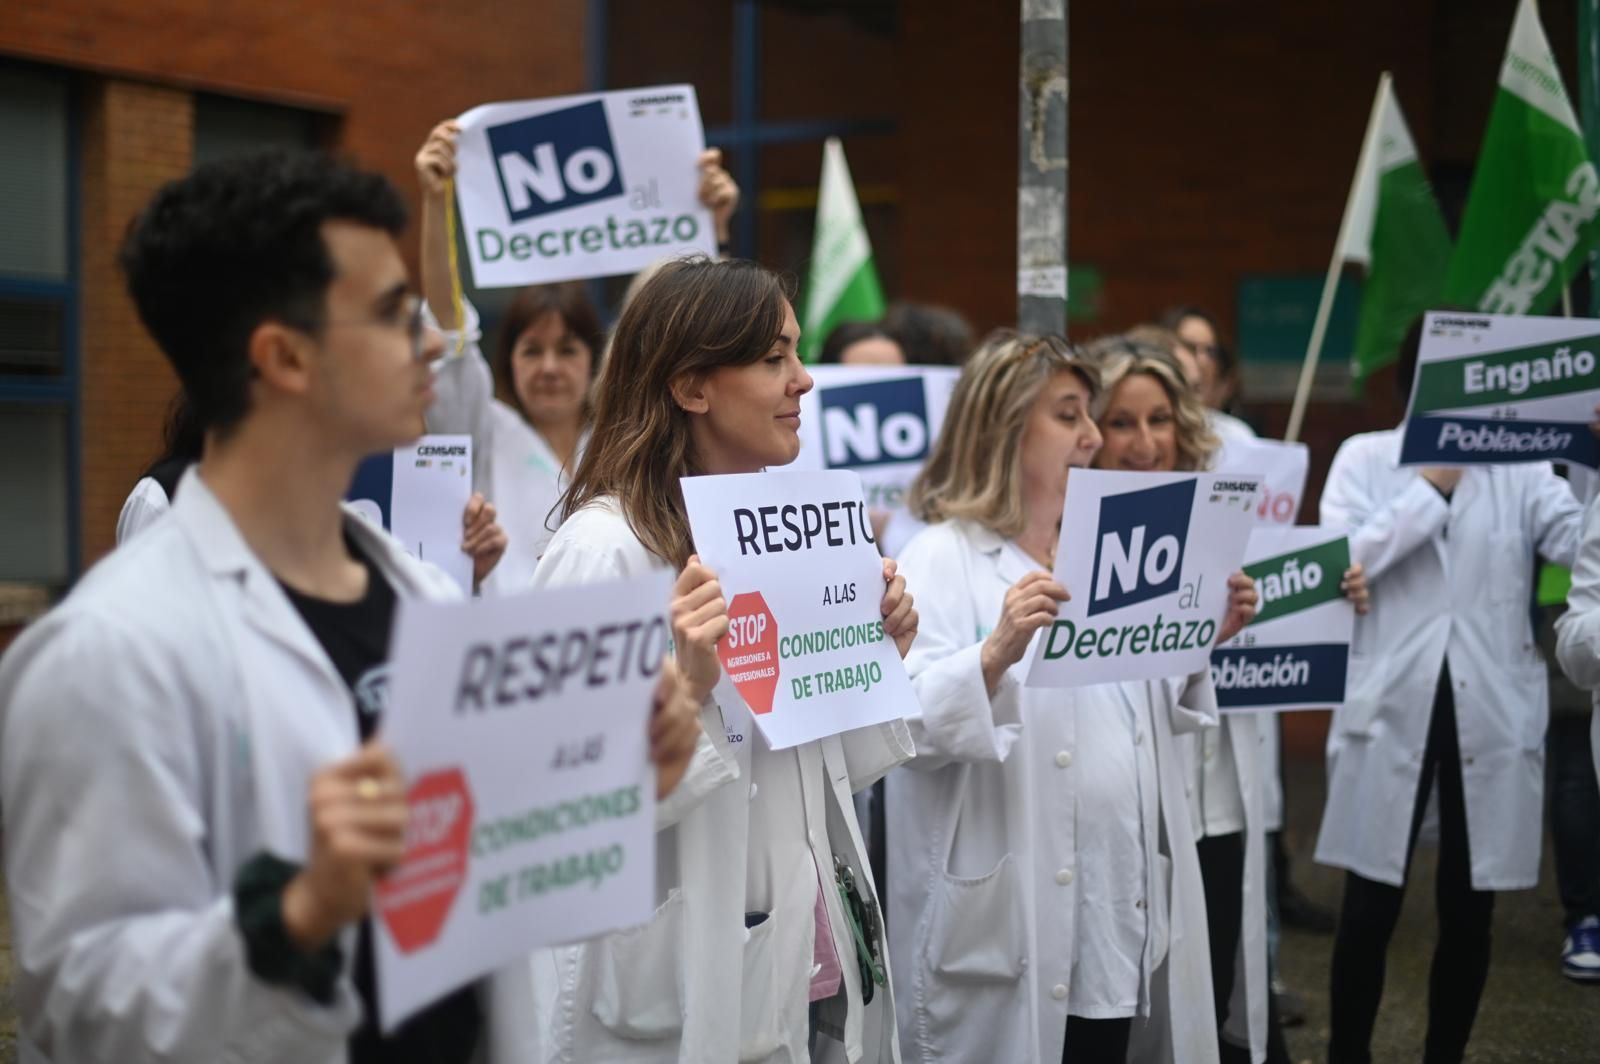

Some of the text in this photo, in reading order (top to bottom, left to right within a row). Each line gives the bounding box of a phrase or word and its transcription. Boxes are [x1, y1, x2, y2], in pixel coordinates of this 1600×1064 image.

[498, 142, 615, 213] No
[629, 178, 660, 209] al
[476, 214, 699, 263] Decretazo
[1463, 346, 1595, 394] Engaño
[824, 403, 926, 464] No
[1437, 421, 1572, 452] Población
[1095, 524, 1180, 601] No
[823, 582, 857, 606] A LAS
[1178, 573, 1203, 610] al
[727, 612, 767, 648] STOP
[779, 620, 884, 659] CONDICIONES
[1043, 613, 1216, 660] Decretazo
[456, 617, 666, 713] RESPETO
[727, 652, 766, 668] AGRESIONES
[791, 661, 882, 700] DE TRABAJO
[472, 784, 643, 858] CONDICIONES
[477, 878, 515, 915] DE
[517, 843, 625, 894] TRABAJO
